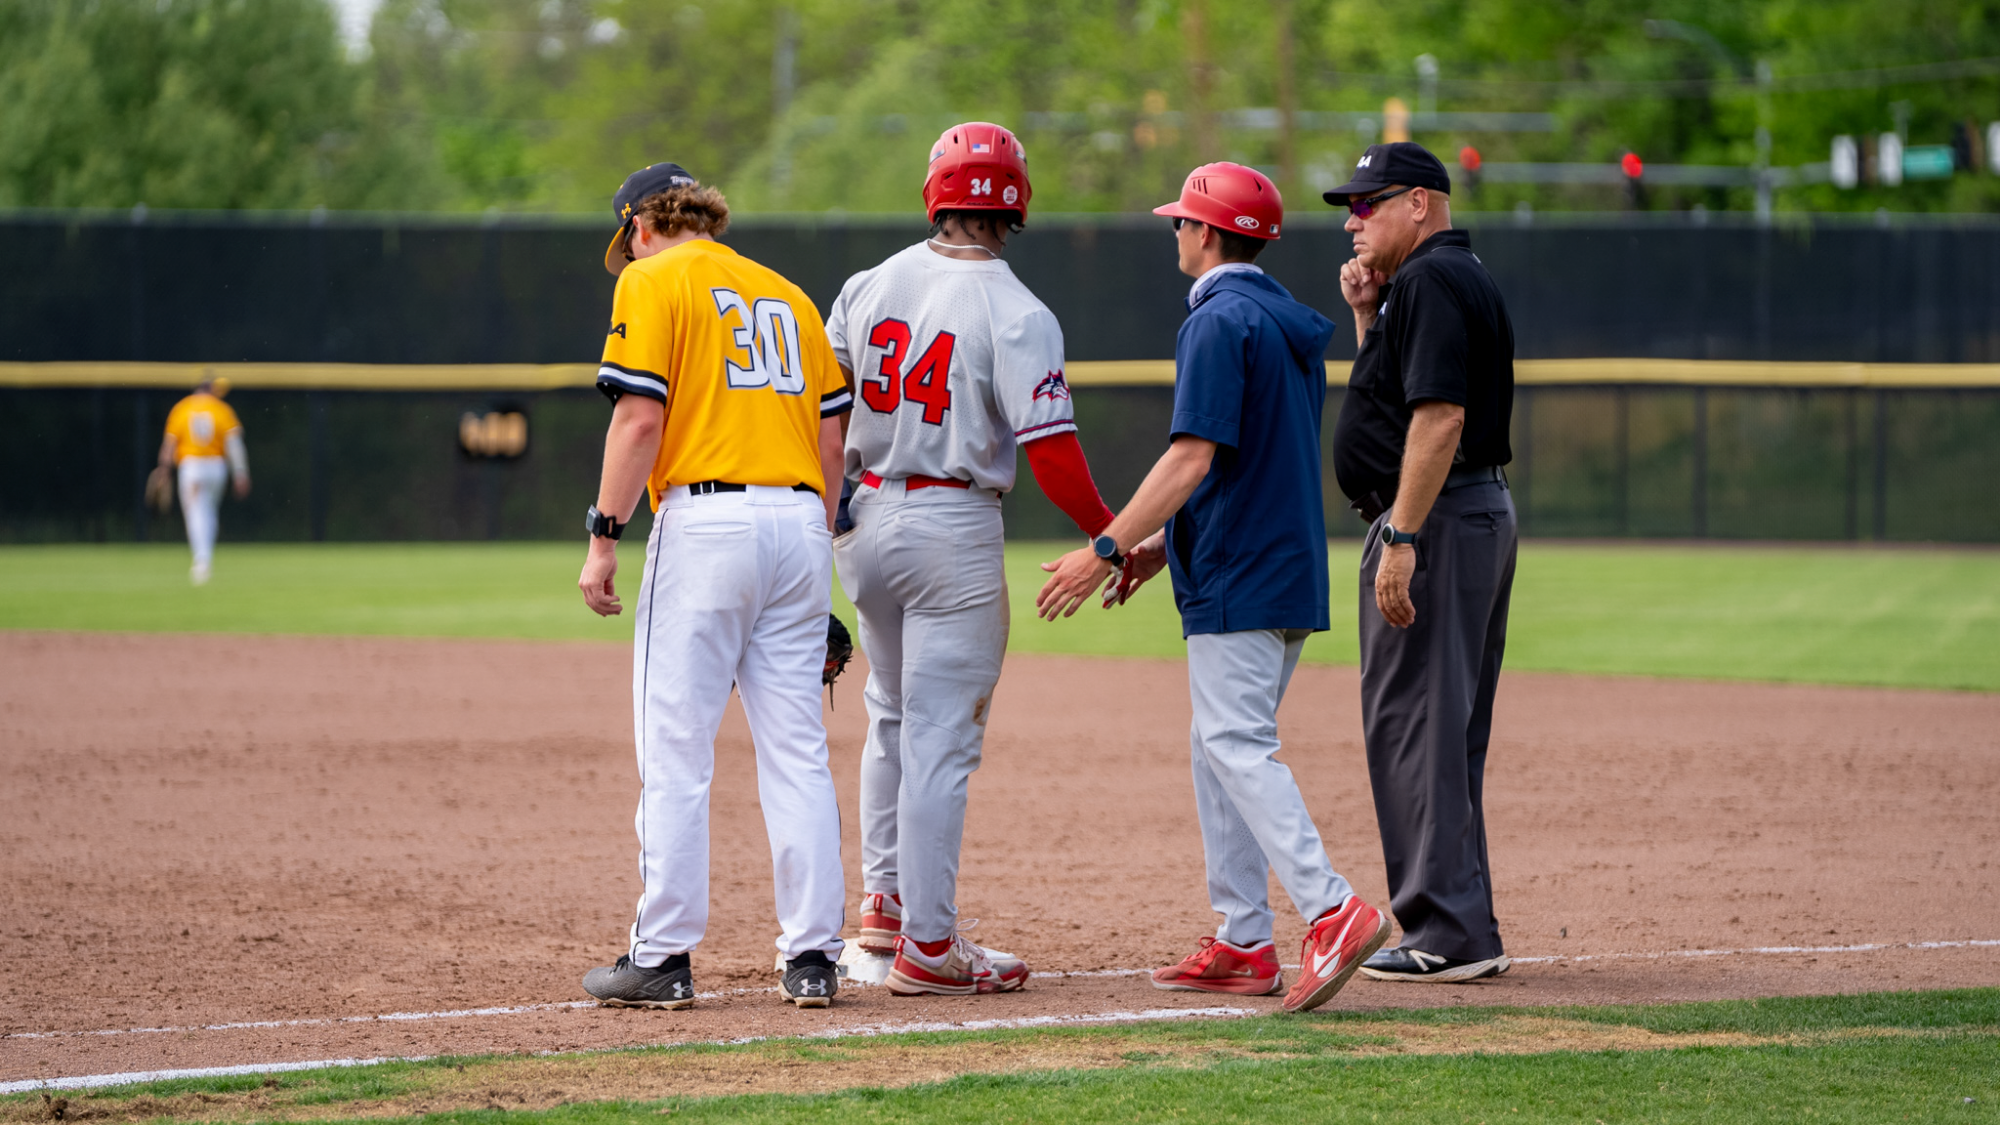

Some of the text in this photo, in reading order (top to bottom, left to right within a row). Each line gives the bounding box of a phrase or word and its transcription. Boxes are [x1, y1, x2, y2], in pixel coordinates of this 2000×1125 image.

[970, 178, 992, 195] 34
[709, 287, 806, 396] 30
[861, 316, 956, 426] 34
